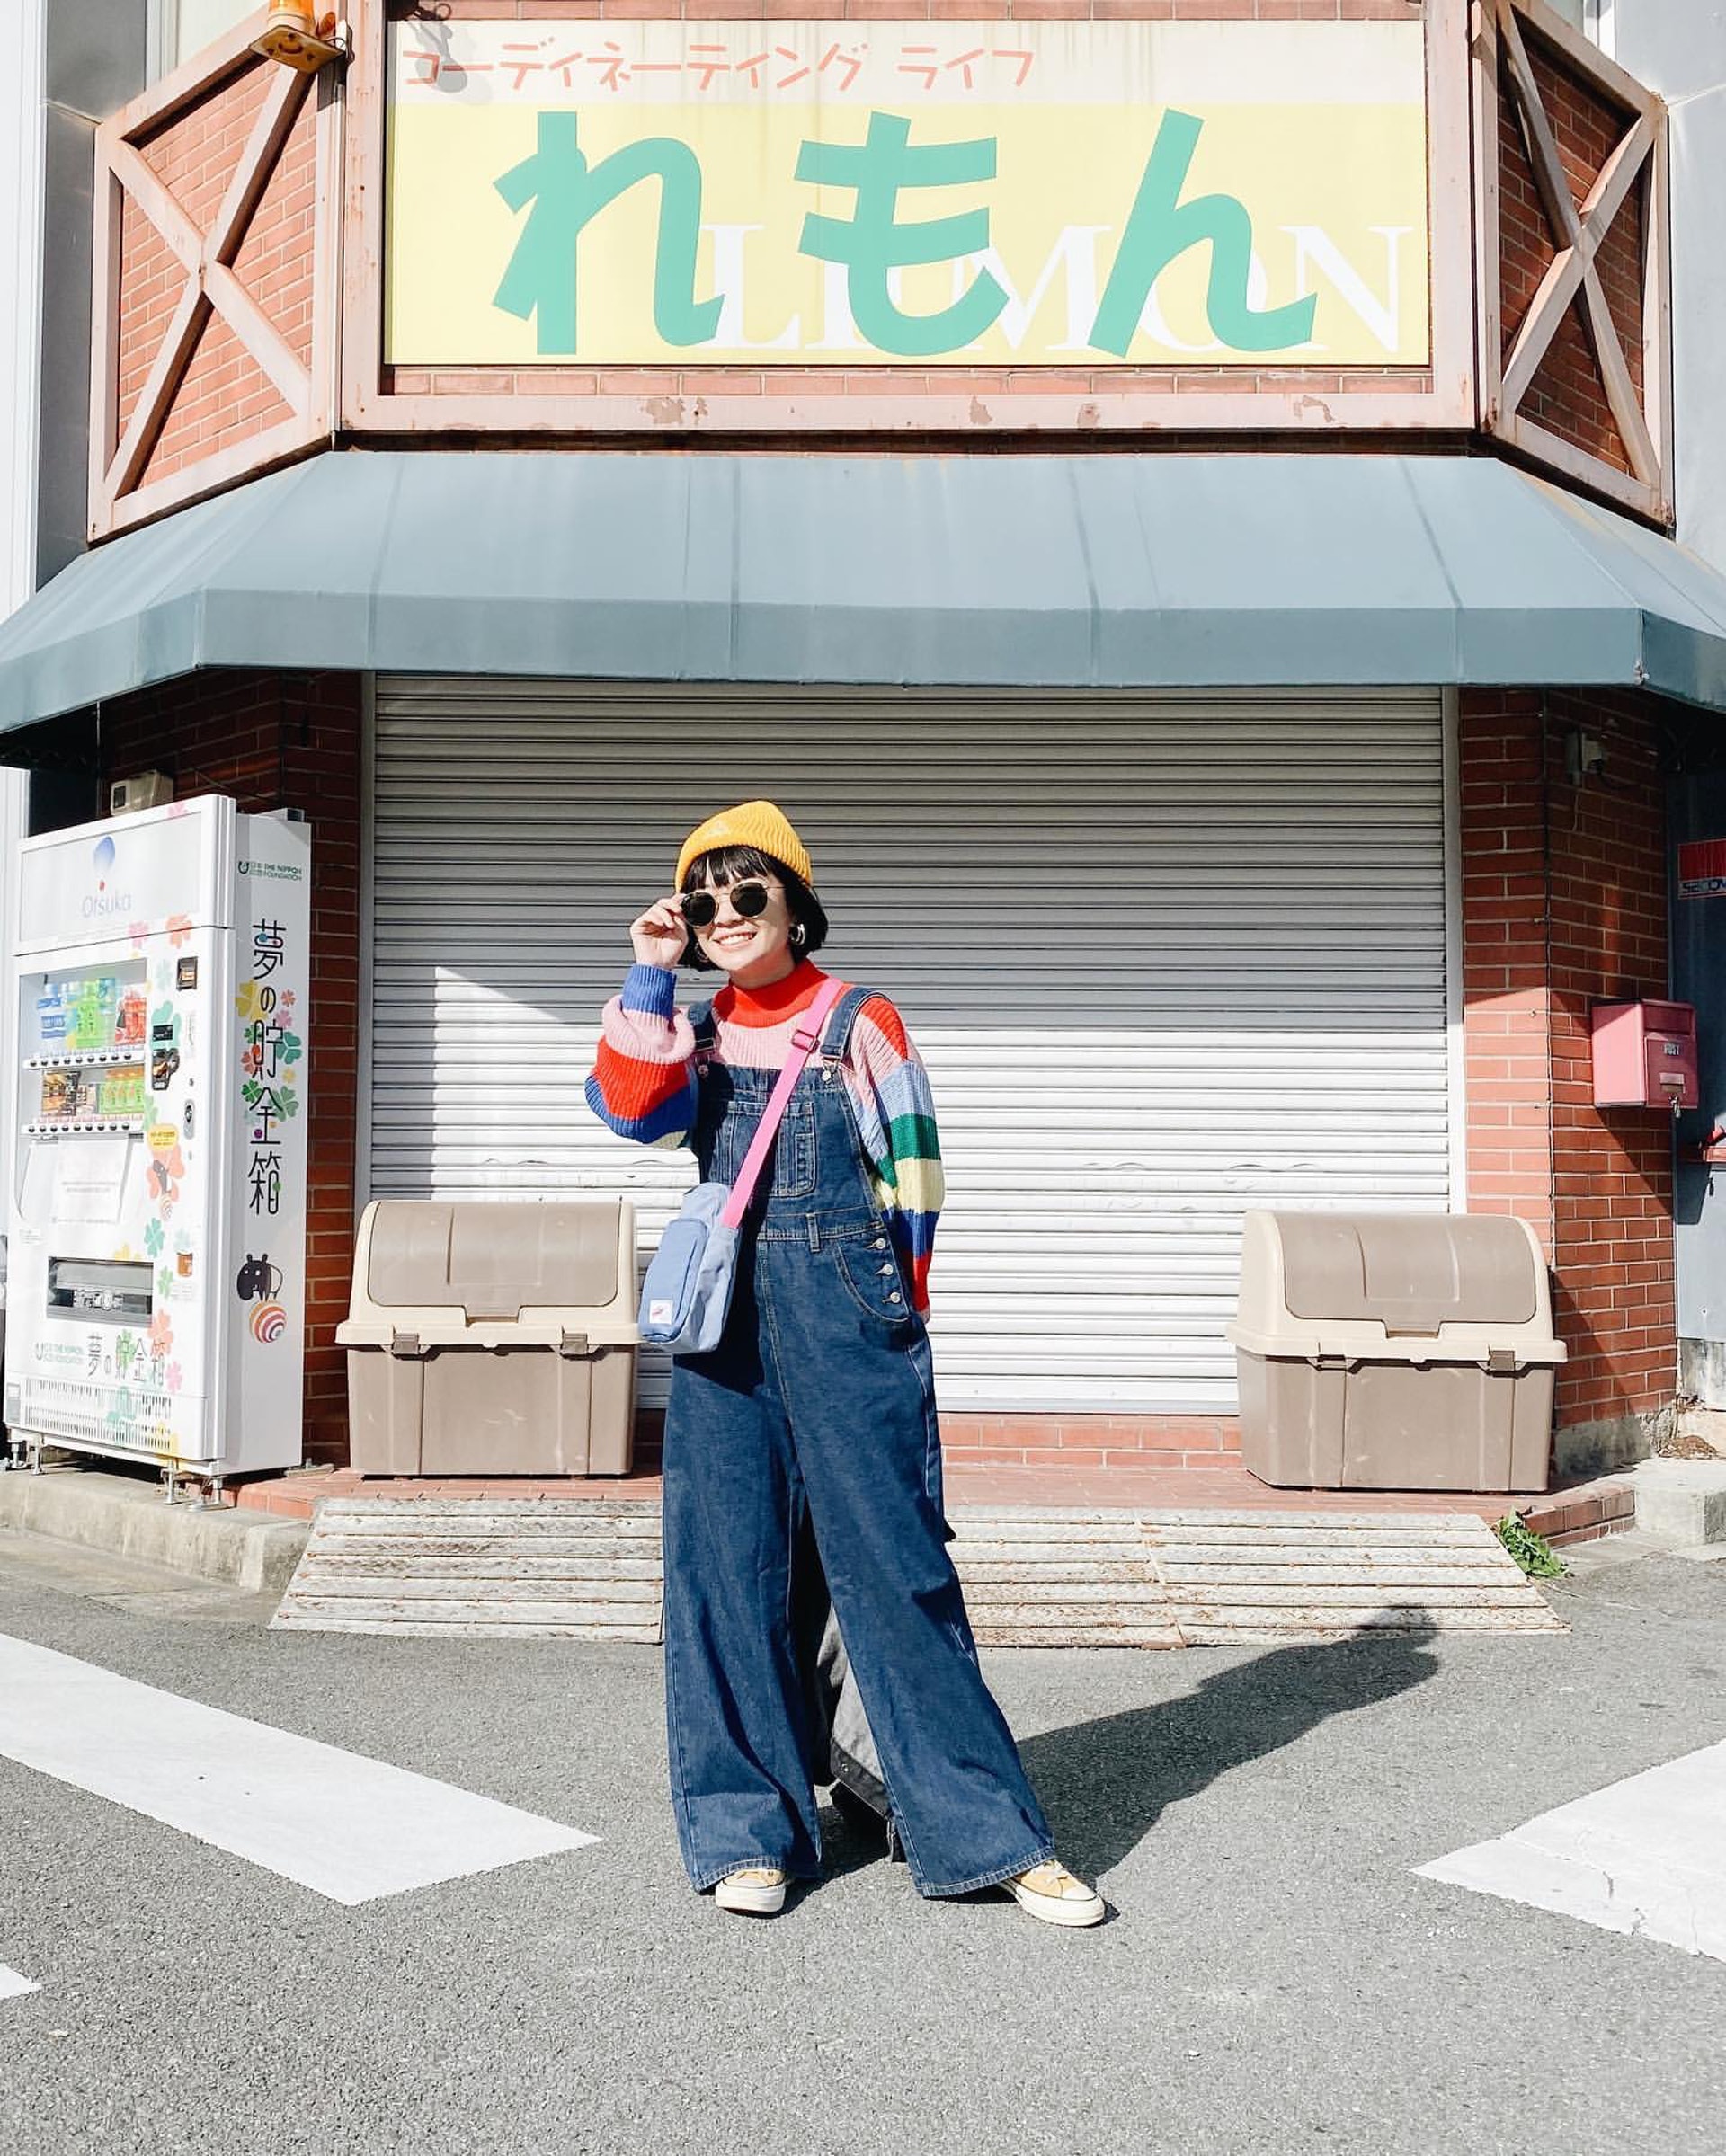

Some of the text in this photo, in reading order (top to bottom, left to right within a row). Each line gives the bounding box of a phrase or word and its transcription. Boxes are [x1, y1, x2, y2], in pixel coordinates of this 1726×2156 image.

[402, 36, 1035, 92] コーディネーティング ライフ
[491, 105, 1318, 359] れもん
[247, 918, 287, 1215] 夢の貯金箱
